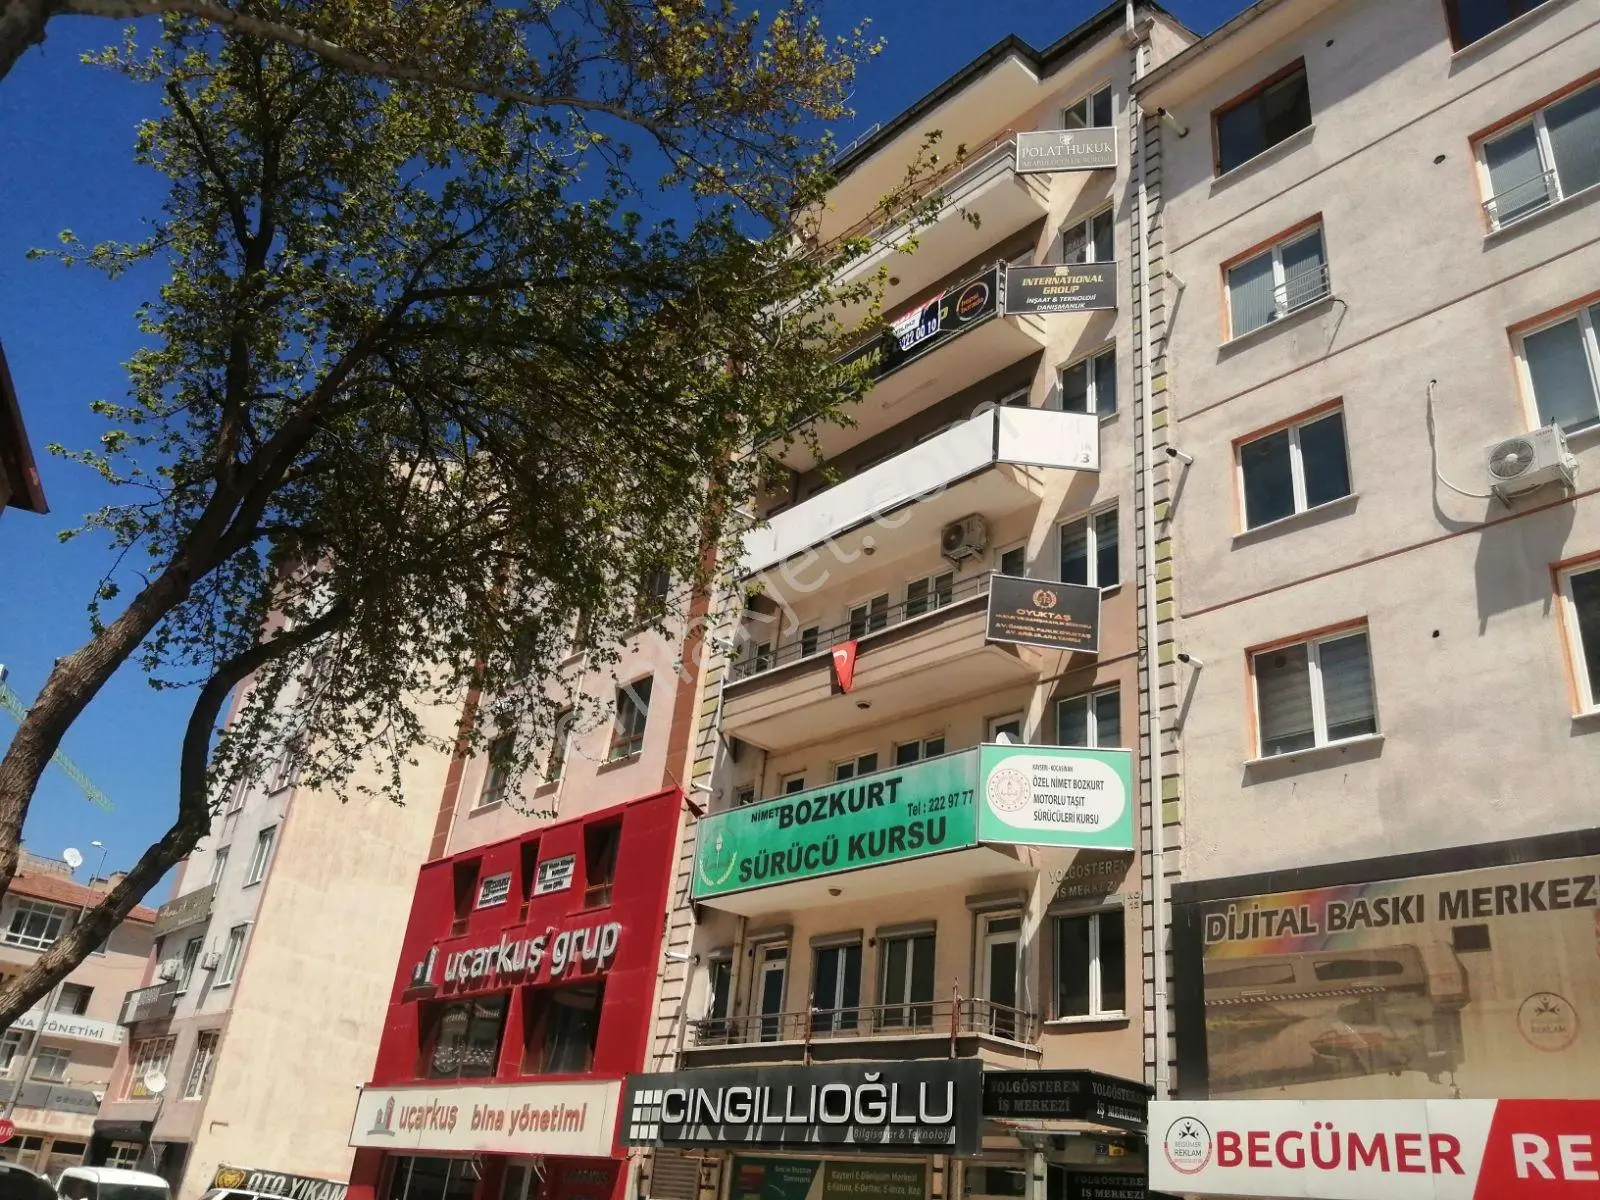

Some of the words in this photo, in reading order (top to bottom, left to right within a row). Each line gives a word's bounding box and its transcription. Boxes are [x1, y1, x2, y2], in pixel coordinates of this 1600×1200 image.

[1022, 145, 1063, 158] POLAT
[1066, 142, 1112, 155] HUKUK
[1022, 274, 1103, 286] INTERNATIONAL
[1042, 285, 1080, 295] GROUP
[1016, 608, 1072, 623] OYUKTAŞ
[1032, 775, 1049, 788] ÖZEL
[1050, 777, 1072, 789] NİMET
[1073, 778, 1105, 791] BOZKURT
[750, 806, 780, 823] NİMET
[778, 777, 902, 830] BOZKURT
[929, 796, 946, 814] 222
[948, 793, 960, 808] 97
[962, 789, 975, 805] 77
[1033, 794, 1066, 806] MOTORLU
[1067, 796, 1085, 808] TAŞIT
[1076, 813, 1099, 825] KURSU
[739, 834, 839, 883] SÜRÜCÜ
[847, 816, 946, 861] KURSU
[1205, 903, 1318, 944] DİJİTAL
[1326, 893, 1425, 933] BASKI
[1438, 874, 1600, 921] MERKEZ
[443, 931, 546, 984] uçarkuş
[550, 922, 622, 975] grup
[991, 1078, 1080, 1093] YOLGÖSTEREN
[661, 1071, 954, 1124] CINGILLIOĞLU
[1013, 1096, 1071, 1112] MERKEZİ
[399, 1098, 459, 1134] uçarkuş
[470, 1104, 504, 1132] bina
[508, 1102, 588, 1137] yönetimi
[1174, 1149, 1202, 1157] REKLAM
[1216, 1121, 1466, 1176] BEGÜMER
[246, 1172, 286, 1192] OTO
[289, 1177, 349, 1200] YIKAM
